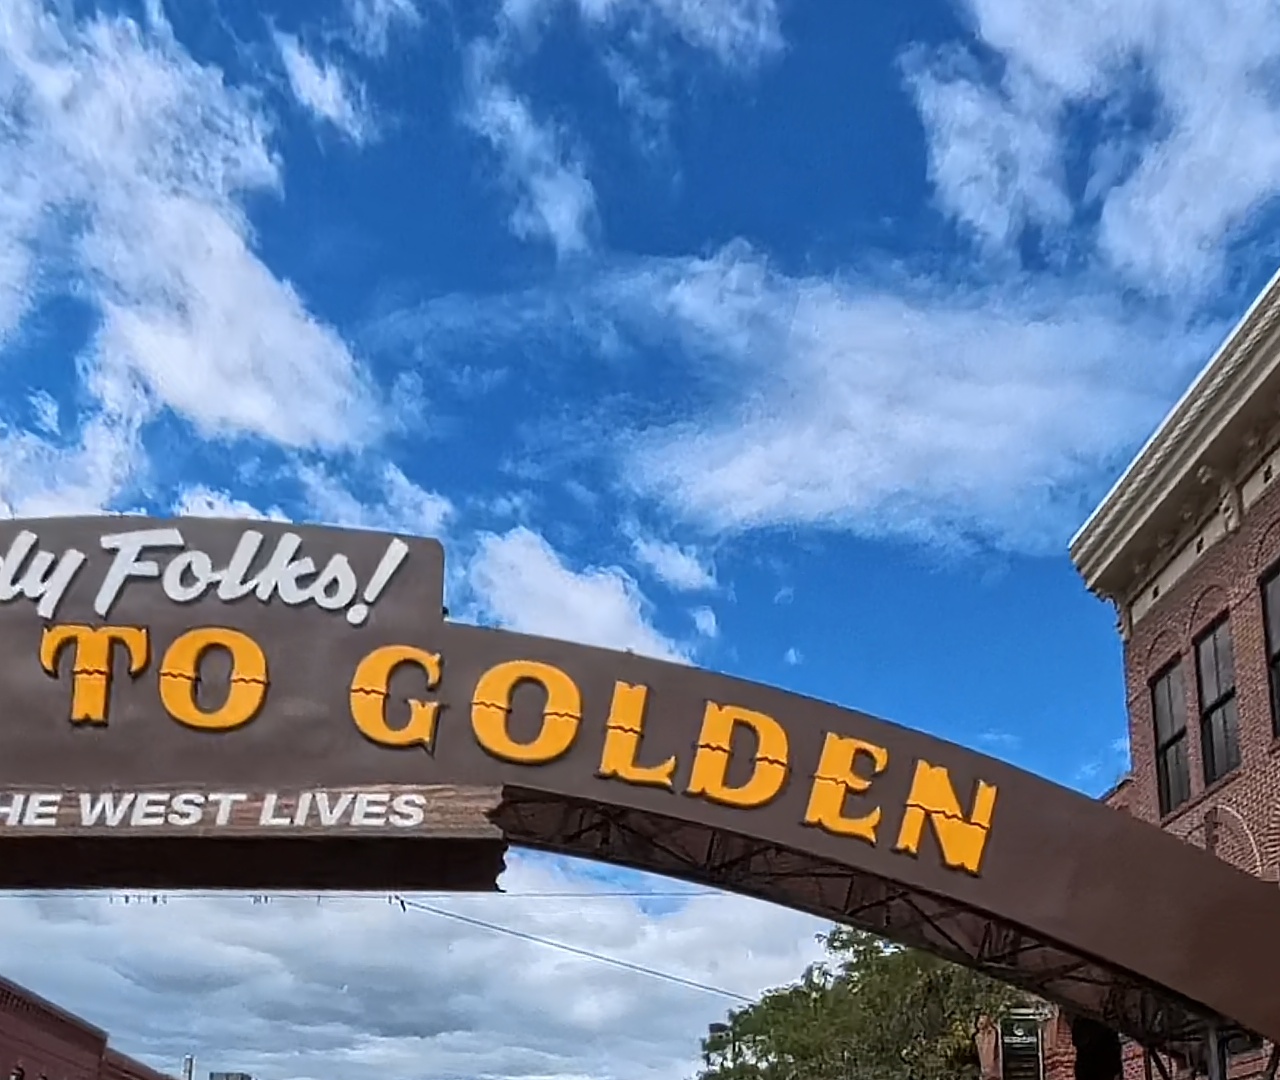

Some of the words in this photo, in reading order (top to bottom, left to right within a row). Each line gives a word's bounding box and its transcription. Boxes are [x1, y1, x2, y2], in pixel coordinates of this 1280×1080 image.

[93, 527, 409, 625] Folks!
[38, 622, 269, 733] TO
[348, 644, 999, 875] GOLDEN
[75, 791, 254, 828] WEST
[258, 790, 428, 828] LIVES
